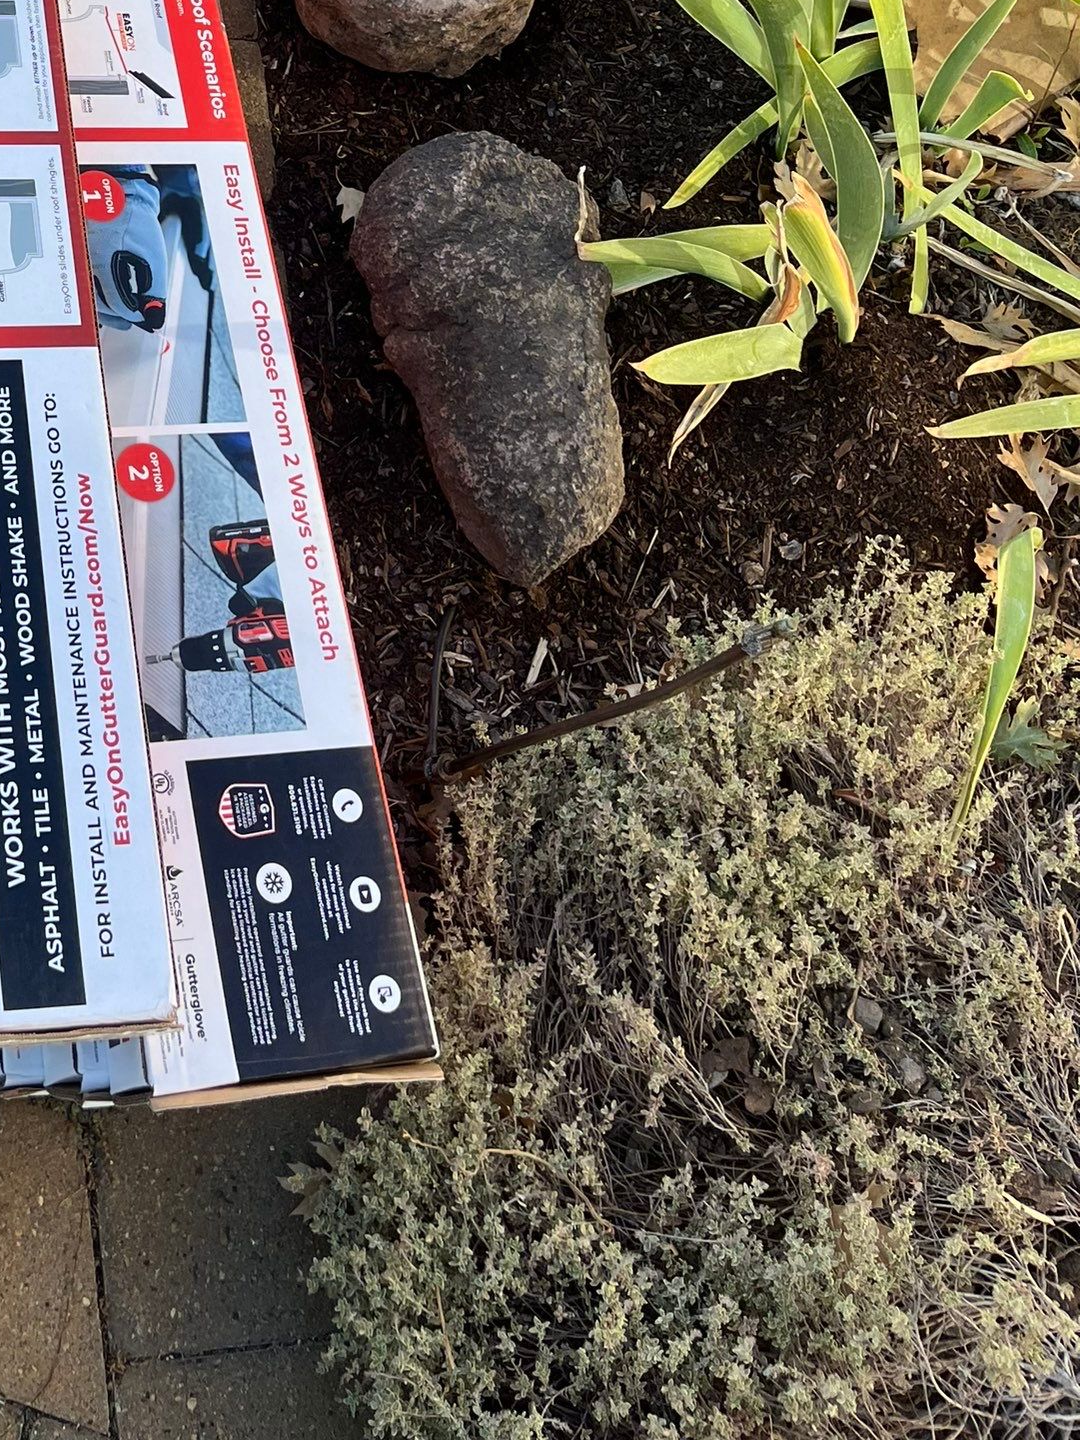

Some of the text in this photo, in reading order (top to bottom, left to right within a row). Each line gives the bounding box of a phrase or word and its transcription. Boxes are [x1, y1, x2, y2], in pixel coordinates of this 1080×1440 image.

[196, 29, 229, 118] Scenarios
[82, 190, 101, 202] 1
[100, 177, 116, 214] OPTION
[219, 164, 339, 660] Easy Install Choose From 2 Ways to Attach
[0, 449, 19, 495] AND
[128, 464, 149, 480] 2
[147, 451, 164, 492] OPTION
[7, 516, 28, 586] SHAKE
[13, 592, 35, 665] WOOD
[71, 473, 134, 844] EasyOnGutterGuard.com/Now
[42, 393, 114, 957] FOR INSTALL AND MAINTENANCE INSTRUCTIONS GO TO:
[23, 688, 45, 762] METAL
[0, 780, 26, 887] WORKS
[31, 787, 51, 837] TILE
[38, 860, 65, 973] ASPHALT
[284, 910, 298, 952] Important:
